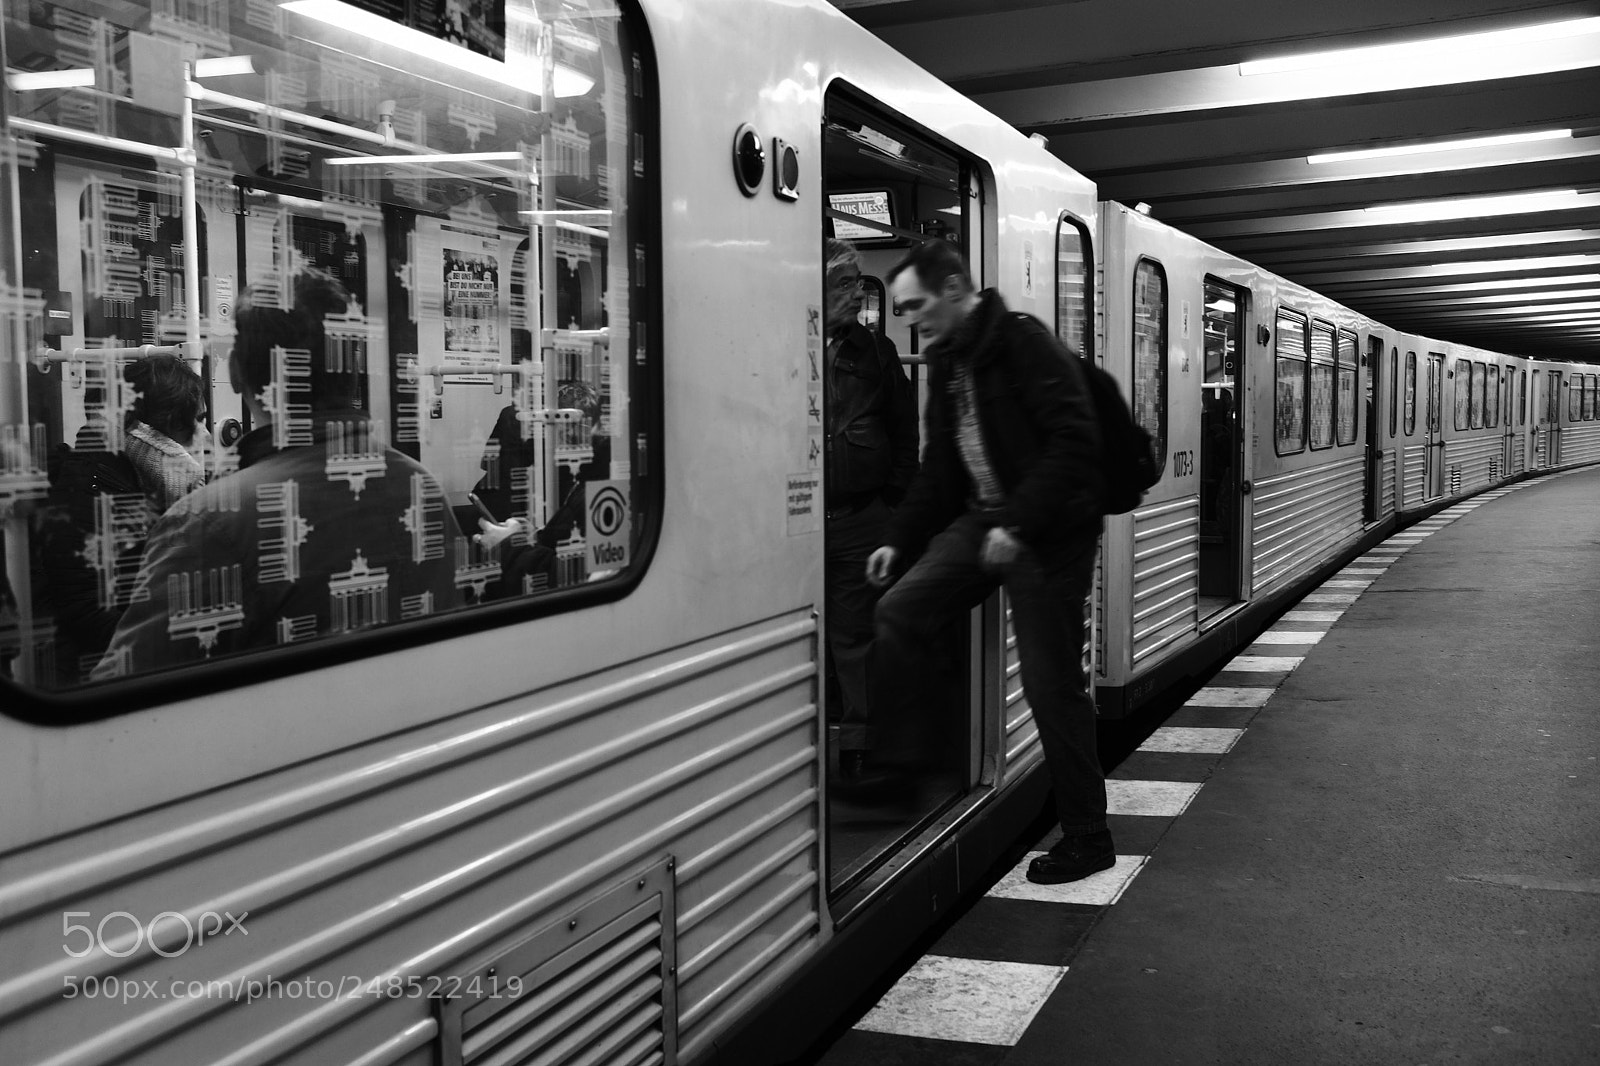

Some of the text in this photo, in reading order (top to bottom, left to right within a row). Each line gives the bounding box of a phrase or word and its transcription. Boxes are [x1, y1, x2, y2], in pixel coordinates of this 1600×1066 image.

[858, 201, 888, 214] MESSE
[461, 272, 472, 280] UNS
[449, 281, 460, 289] BIST
[460, 281, 468, 289] DU
[468, 282, 483, 290] NICHT
[1174, 450, 1193, 477] 1073-3
[592, 541, 625, 565] Video
